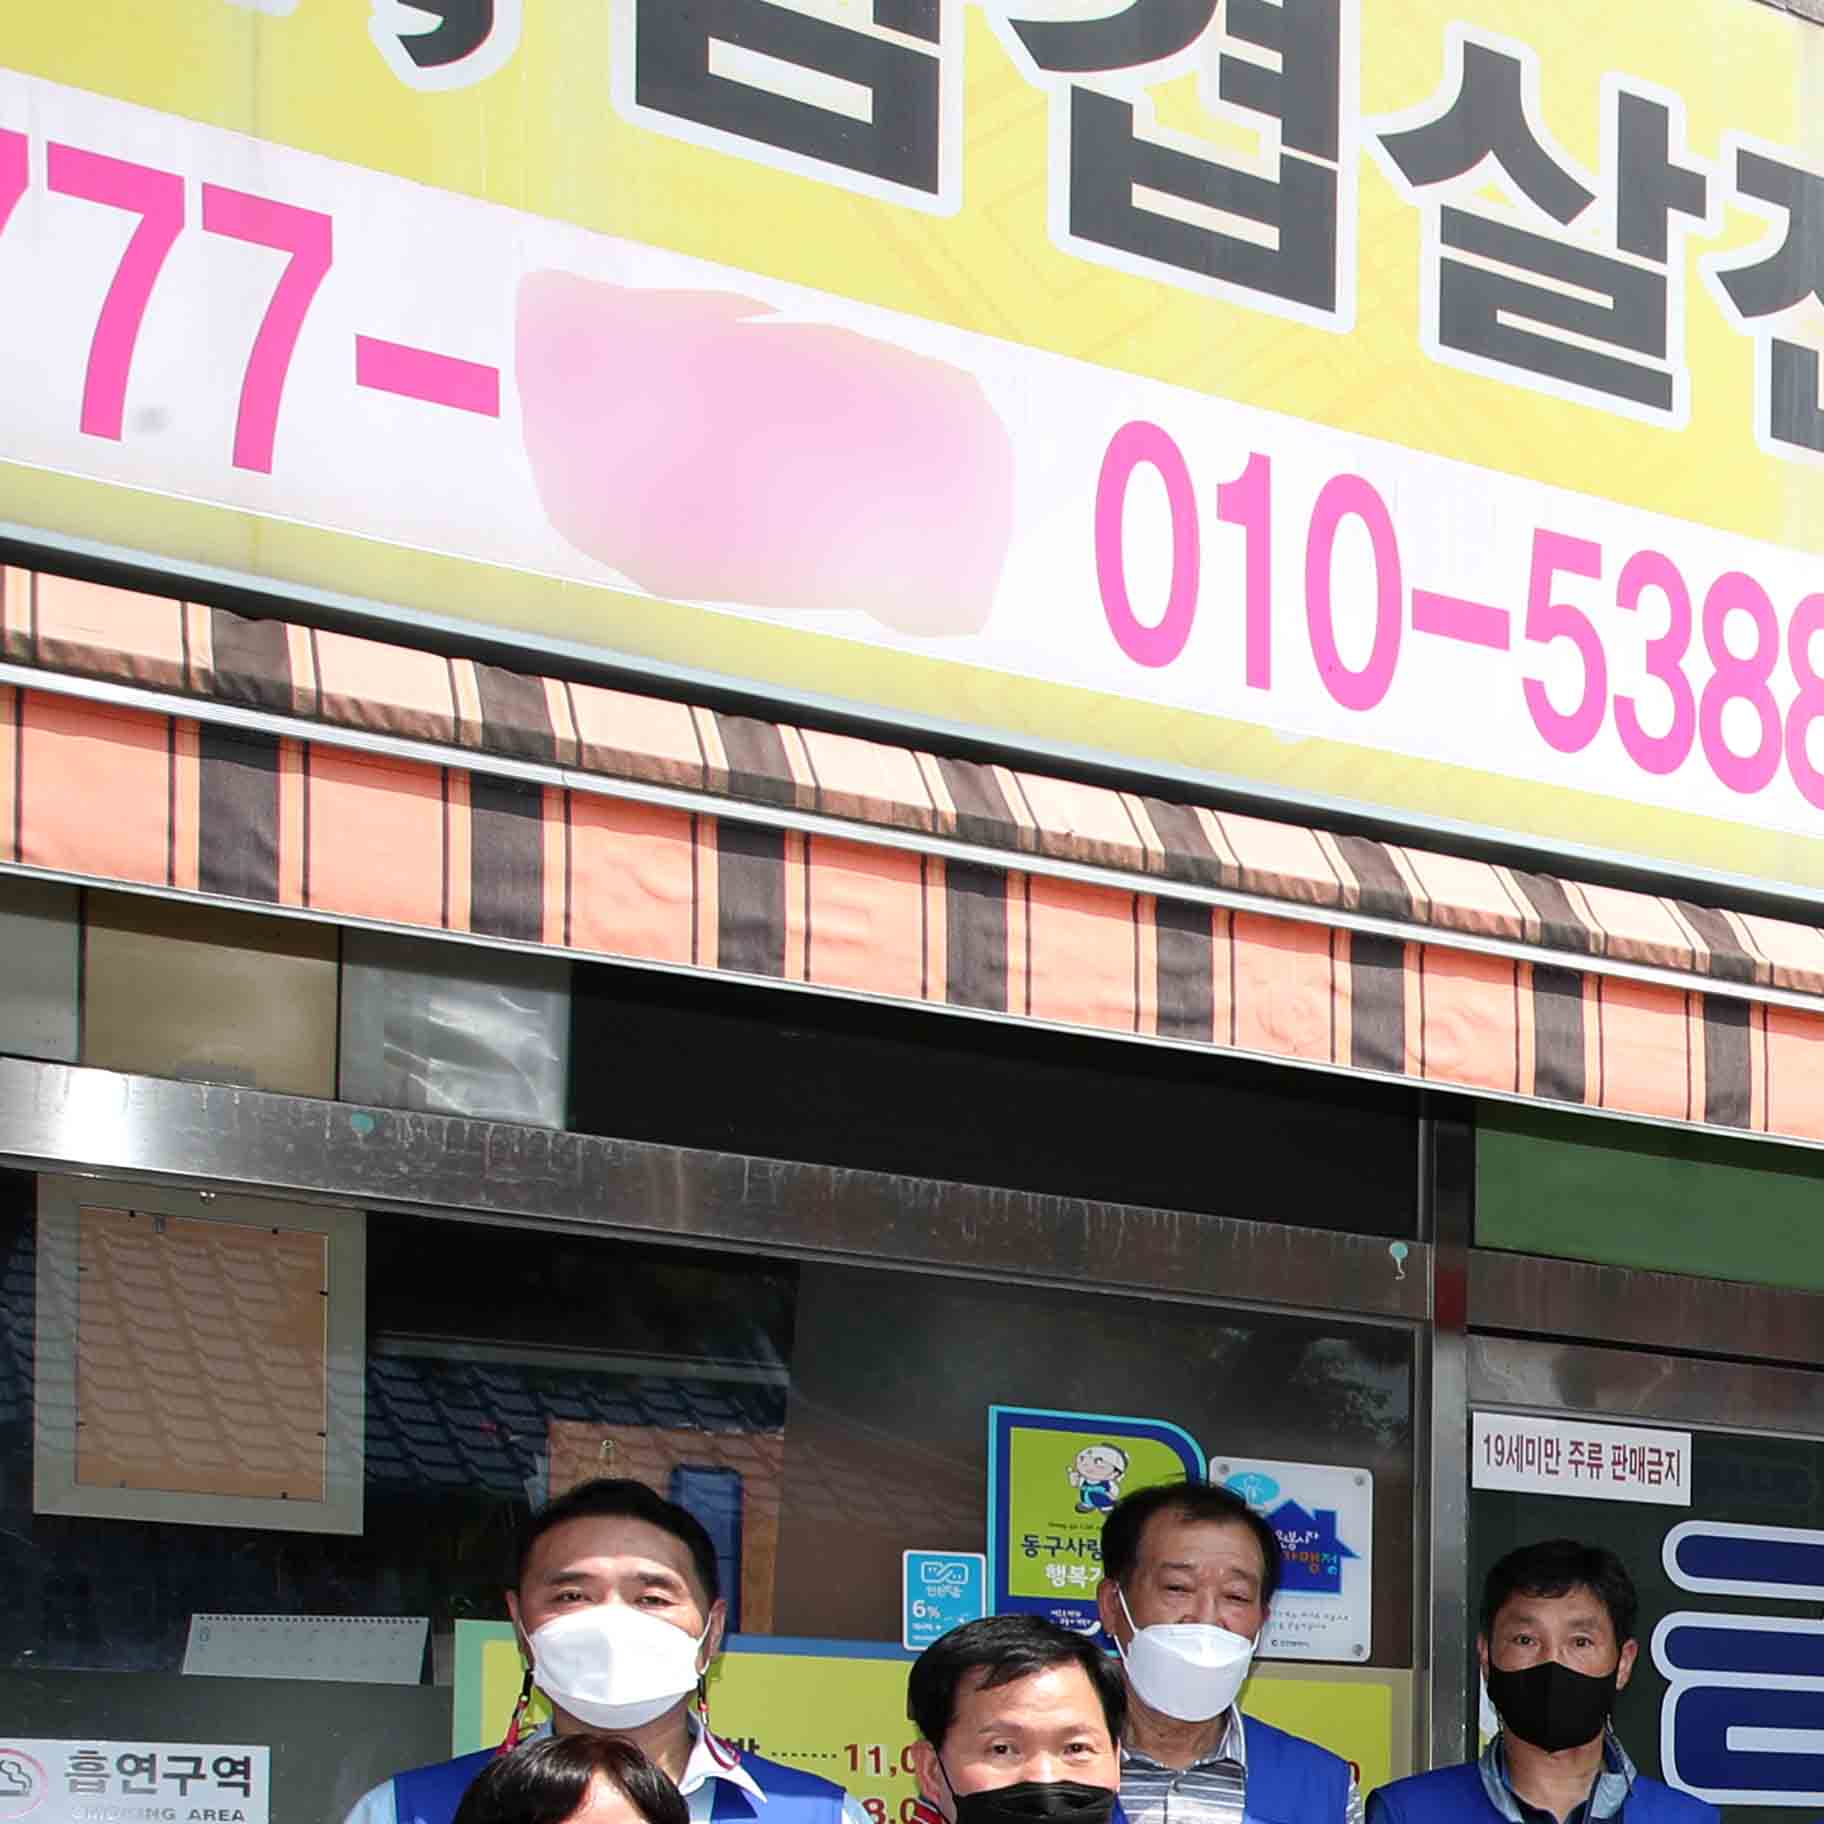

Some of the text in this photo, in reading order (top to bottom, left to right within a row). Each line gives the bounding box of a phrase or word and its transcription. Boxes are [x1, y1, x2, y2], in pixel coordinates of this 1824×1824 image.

[1483, 1434, 1681, 1487] 19세미만 주류 판매금지
[63, 1749, 252, 1798] 흡연구역
[187, 1808, 246, 1822] AREA
